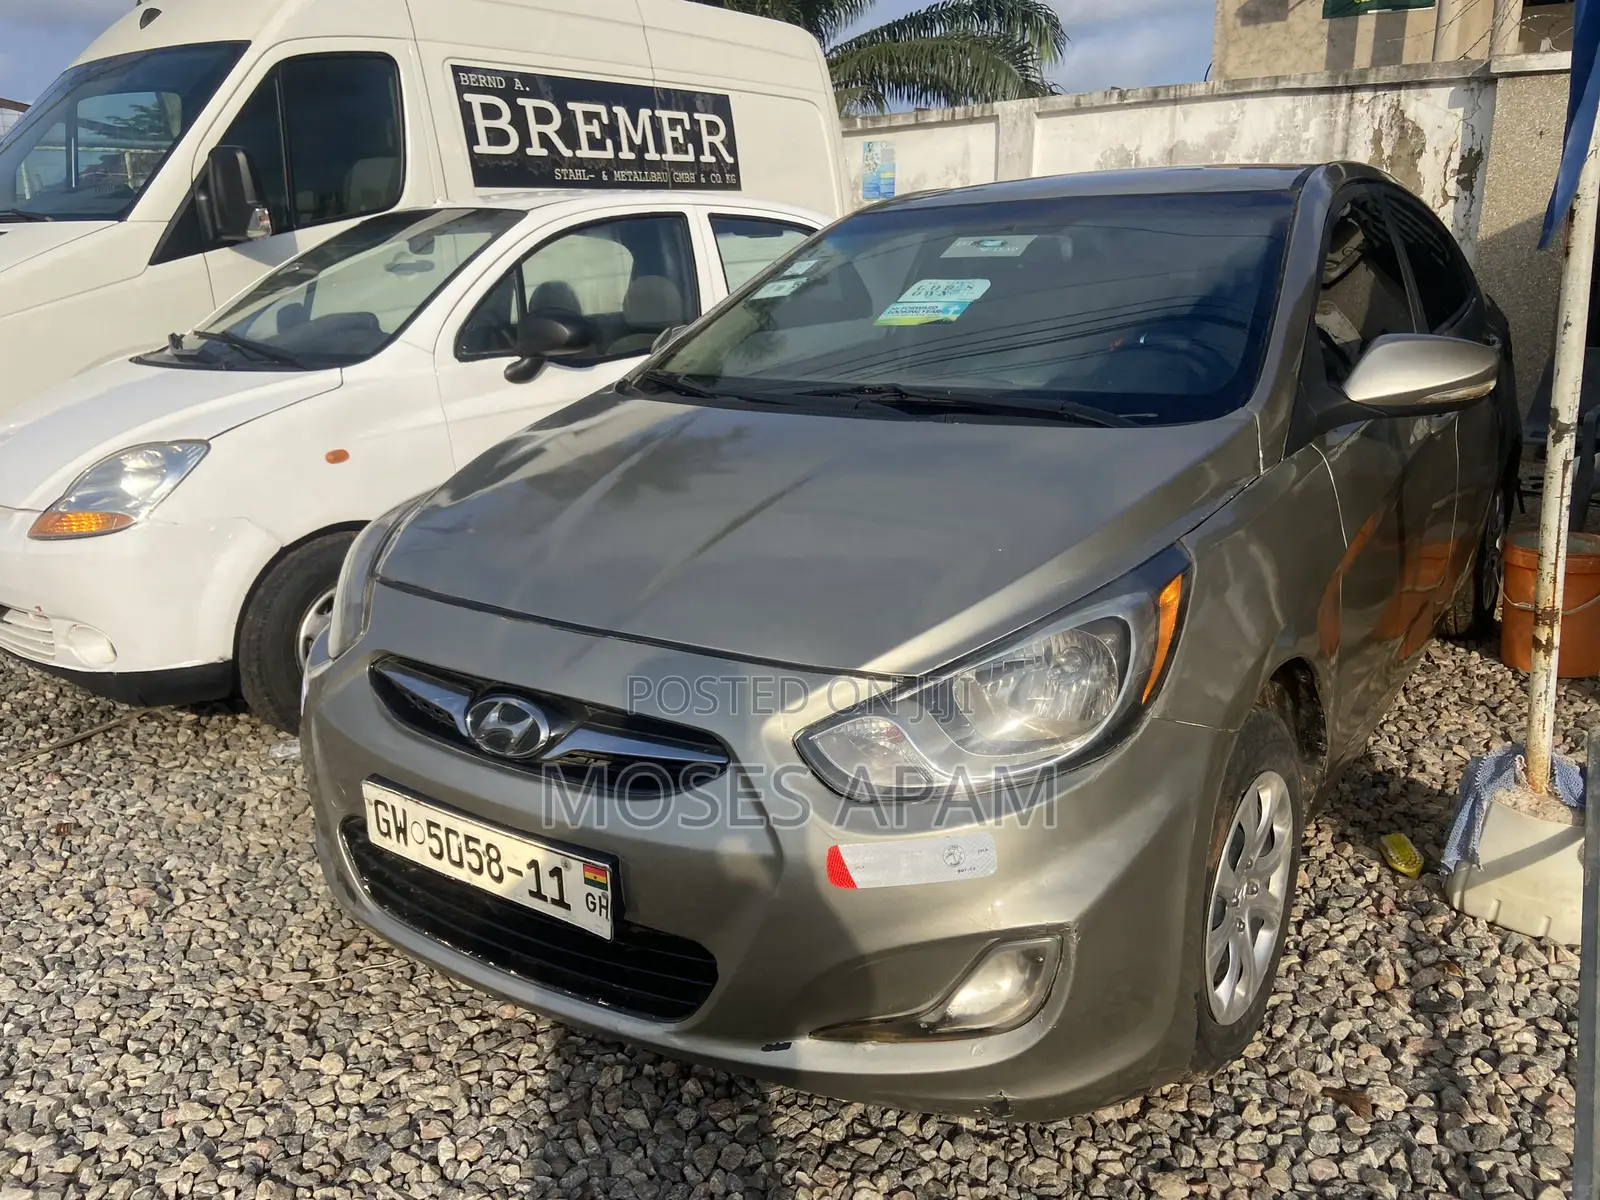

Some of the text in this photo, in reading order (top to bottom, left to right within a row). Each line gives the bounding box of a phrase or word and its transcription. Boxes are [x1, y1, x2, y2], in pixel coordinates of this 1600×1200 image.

[458, 72, 530, 91] BERND A.
[462, 92, 734, 164] BREMER
[554, 168, 595, 181] STAHL-
[602, 171, 609, 181] &
[614, 170, 669, 183] METALLBAU
[673, 172, 696, 183] GMBH
[700, 173, 706, 183] &
[725, 173, 736, 184] KG
[373, 798, 572, 911] GW 5058-11
[585, 891, 609, 920] GH
